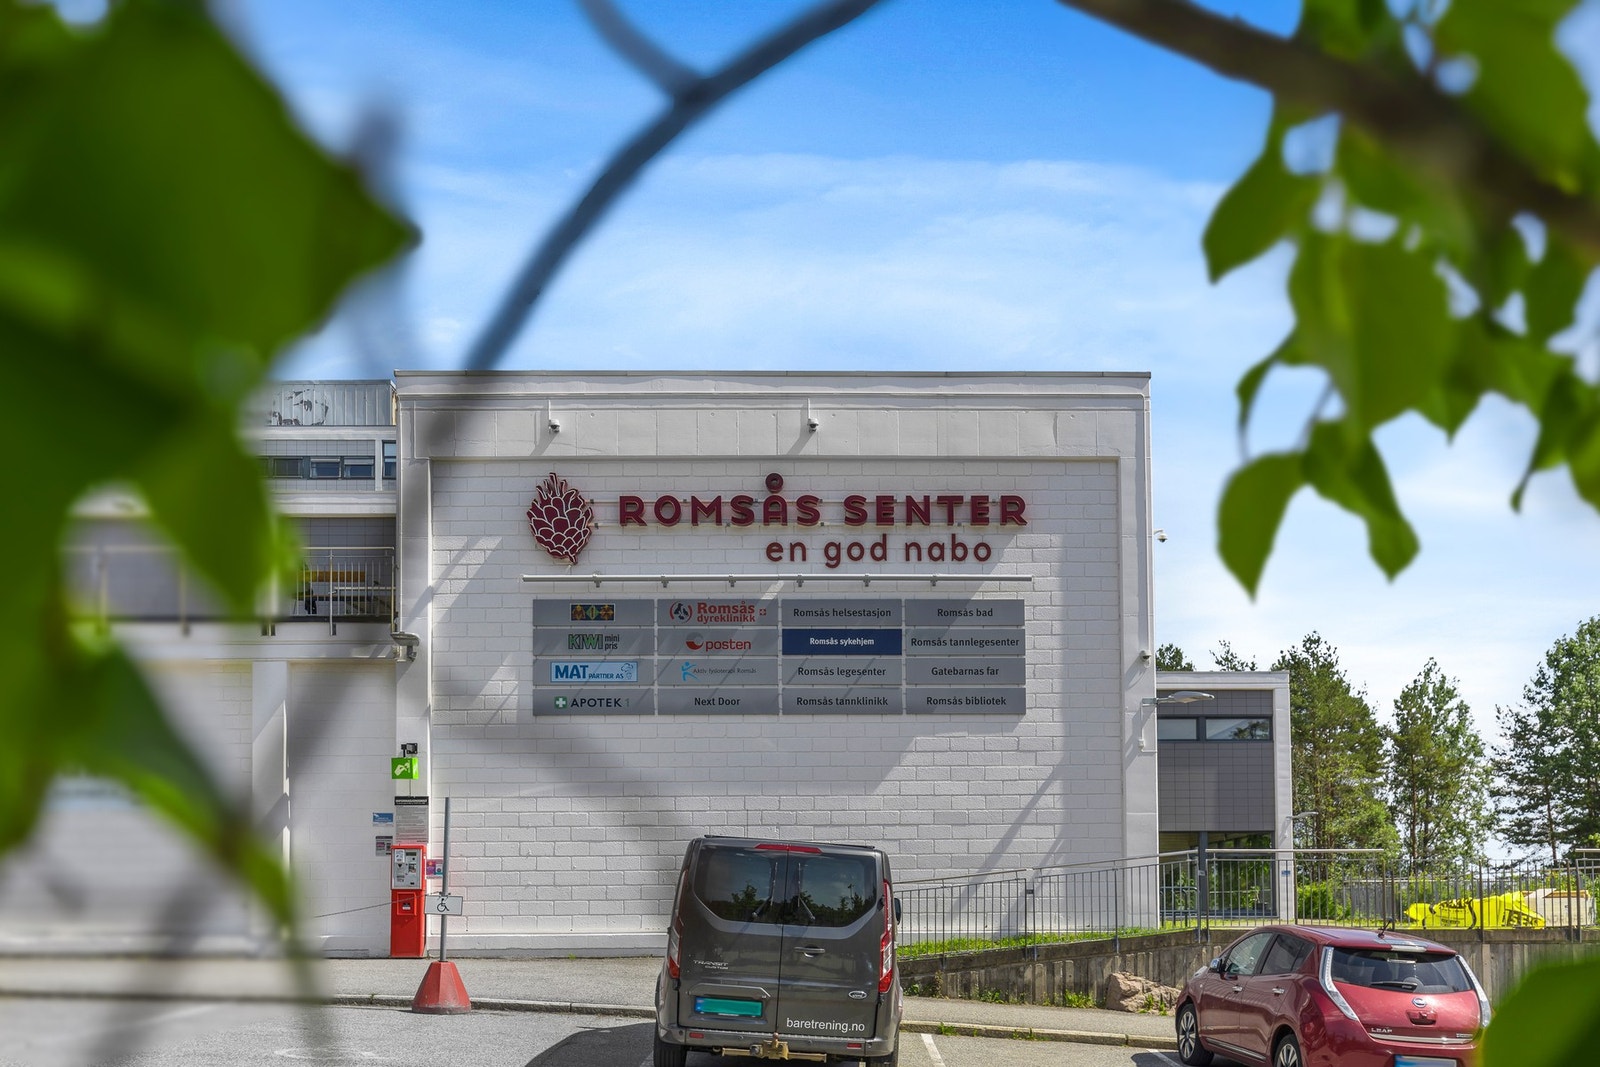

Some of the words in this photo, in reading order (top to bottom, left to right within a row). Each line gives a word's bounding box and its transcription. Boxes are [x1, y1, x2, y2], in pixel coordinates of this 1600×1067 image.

[619, 472, 821, 527] ROMSÅS
[843, 494, 1028, 527] SENTER
[765, 541, 807, 562] en
[823, 533, 888, 569] god
[904, 533, 992, 562] nabo
[697, 601, 755, 614] Romsås
[937, 608, 974, 617] Romsås
[976, 608, 993, 617] bad
[793, 608, 830, 617] Romsås
[832, 608, 891, 618] helsestasjon
[697, 614, 756, 624] dyreklinikk
[568, 634, 603, 649] KIWI
[604, 634, 620, 642] mini
[809, 637, 839, 645] Romsås
[839, 637, 875, 647] sykehjem
[910, 637, 948, 646] Romsås
[949, 637, 1020, 648] tannlegesenter
[604, 642, 618, 651] pris
[705, 639, 751, 651] posten
[554, 665, 589, 679] MAT
[797, 667, 835, 676] Romsås
[836, 667, 887, 677] legesenter
[931, 666, 985, 676] Gatebarnas
[986, 666, 1000, 676] far
[570, 698, 623, 708] APOTEK
[694, 697, 716, 706] Next
[718, 697, 741, 706] Door
[796, 696, 834, 706] Romsås
[835, 696, 889, 706] tannklinikk
[926, 696, 963, 705] Romsås
[965, 696, 1007, 706] bibliotek
[786, 1017, 866, 1033] baretrening.no
